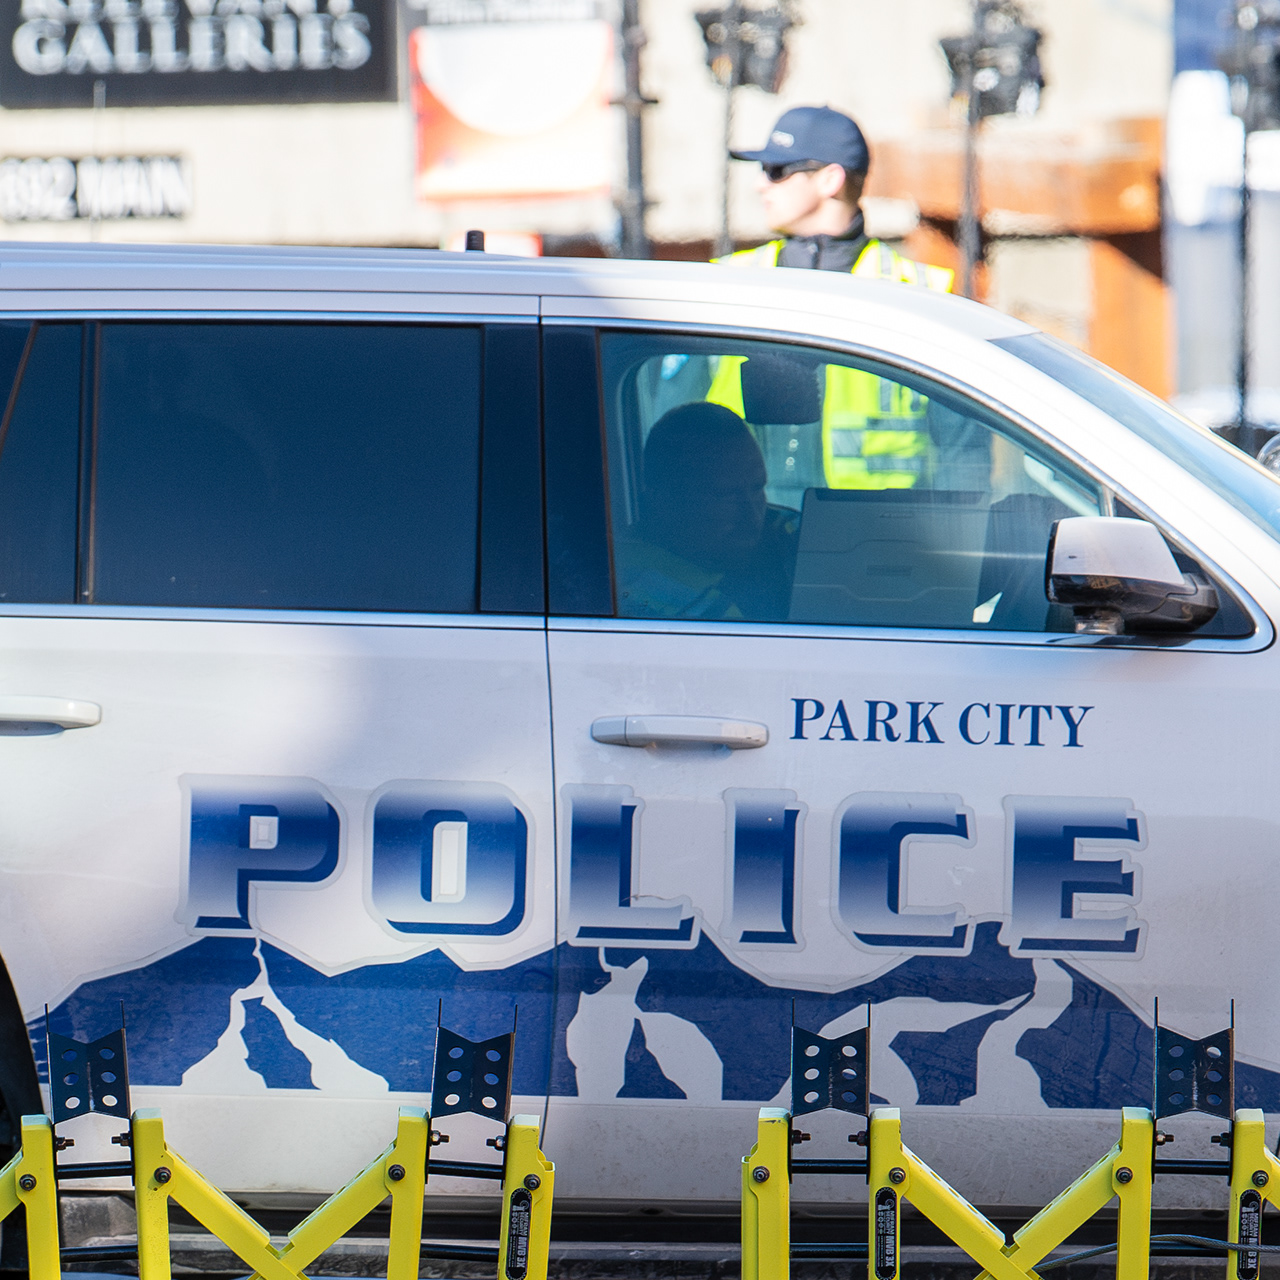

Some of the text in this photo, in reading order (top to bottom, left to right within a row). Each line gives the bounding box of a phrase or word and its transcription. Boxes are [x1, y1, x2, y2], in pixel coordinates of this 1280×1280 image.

[12, 13, 372, 75] GALLERIES
[790, 698, 1095, 747] PARK CITY
[180, 776, 1148, 957] POLICE
[516, 1237, 527, 1268] MVB 3X
[885, 1235, 894, 1267] MVB 3X
[1247, 1238, 1257, 1269] MB 3X
